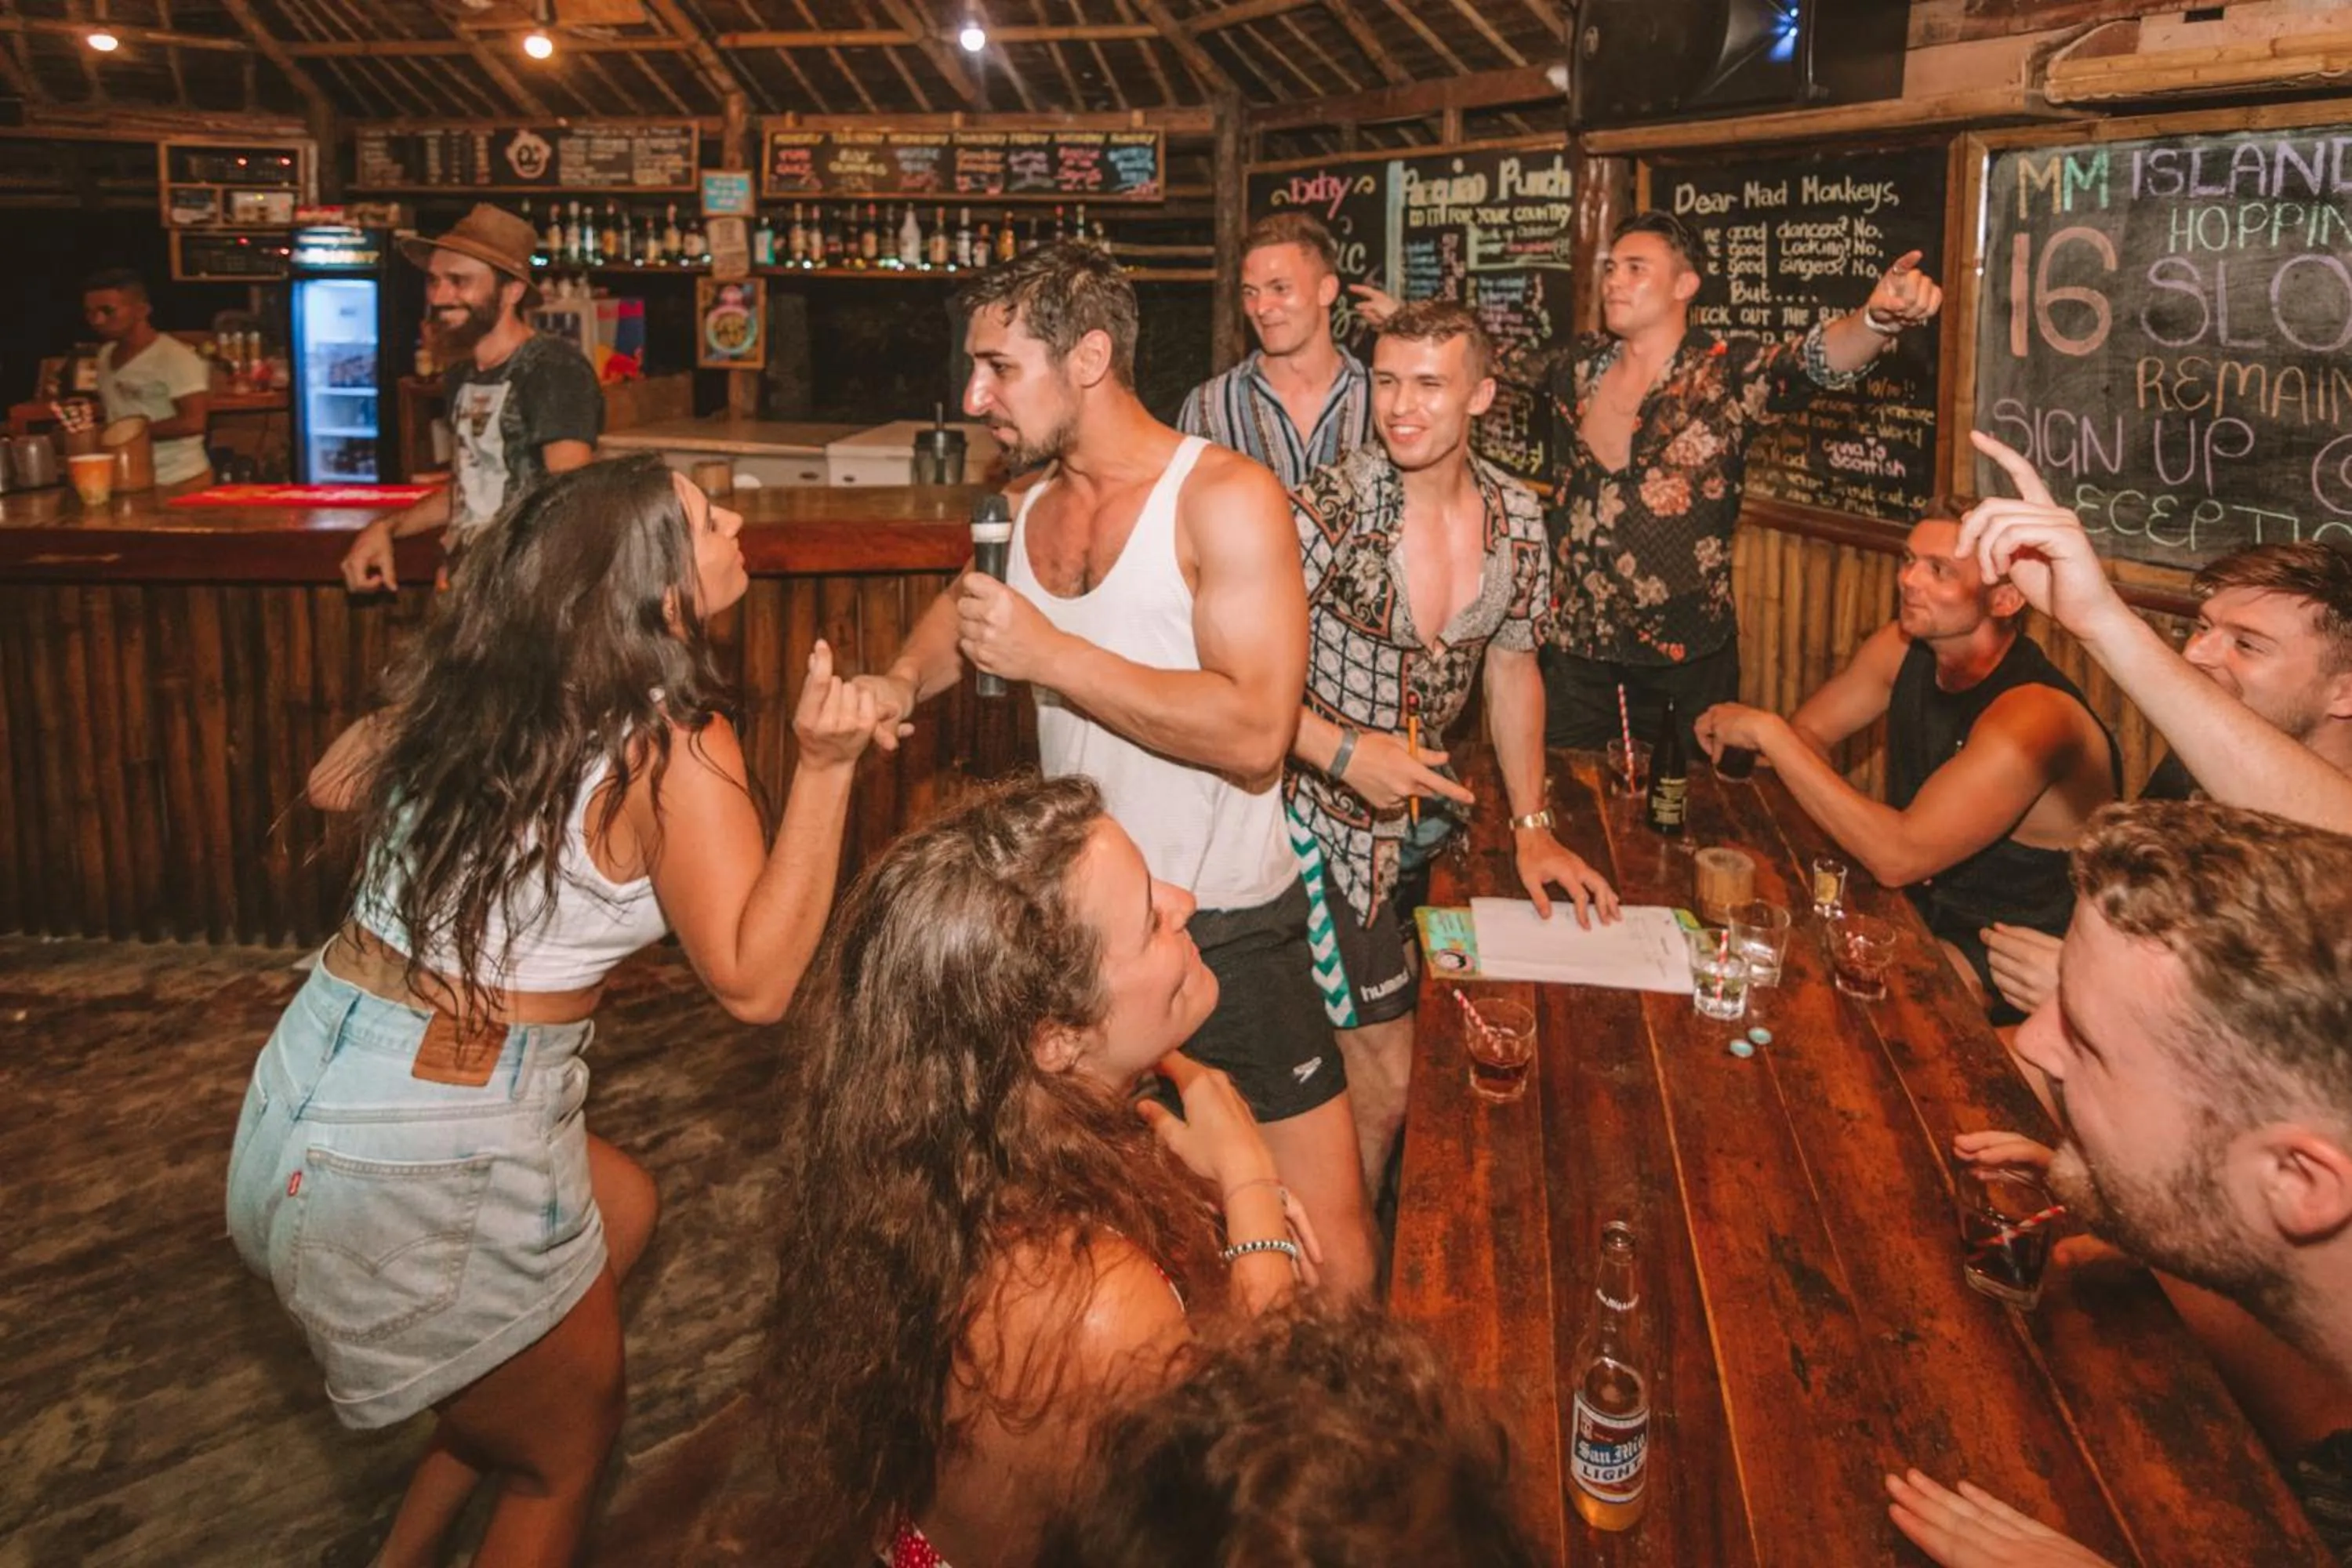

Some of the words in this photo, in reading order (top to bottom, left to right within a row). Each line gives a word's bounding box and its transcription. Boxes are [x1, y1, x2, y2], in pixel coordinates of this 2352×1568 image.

[1497, 155, 1572, 201] Punch
[1675, 183, 1738, 216] Dear
[1744, 179, 1788, 208] Mad
[1802, 174, 1900, 214] Monkeys,
[2018, 151, 2108, 219] MM
[2169, 203, 2352, 252] HOPPIN
[1690, 306, 1732, 326] HECK
[1740, 307, 1772, 326] OUT
[2010, 227, 2117, 357] 16
[2140, 255, 2352, 352] SLO
[2137, 357, 2352, 425] REMAIN
[1993, 398, 2122, 477] SIGN
[2155, 417, 2254, 495] UP
[2074, 484, 2352, 550] ECEPTI
